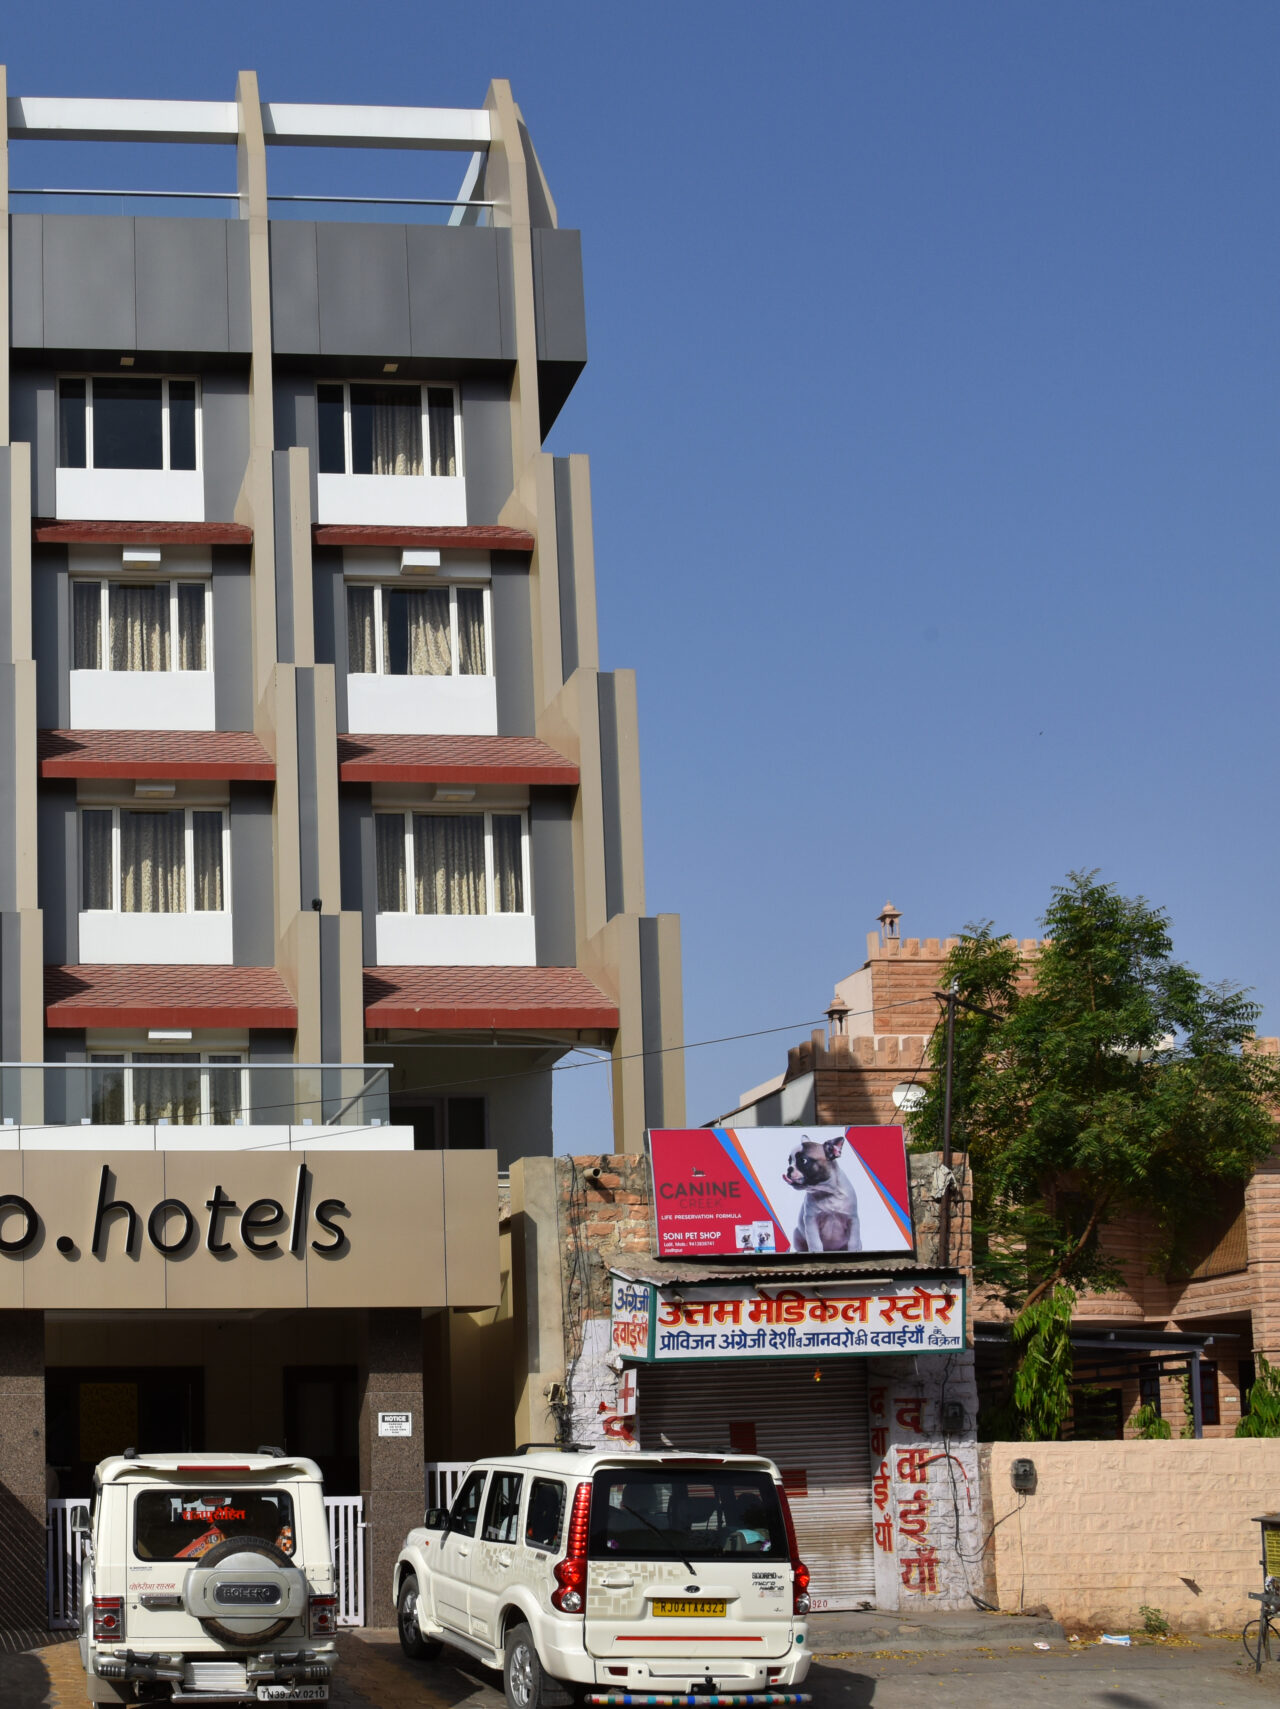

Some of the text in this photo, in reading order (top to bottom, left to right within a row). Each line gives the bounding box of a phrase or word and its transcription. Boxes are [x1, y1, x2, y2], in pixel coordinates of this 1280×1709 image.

[660, 1181, 741, 1199] CANINE
[679, 1199, 723, 1209] CREEK
[663, 1231, 722, 1240] SONI PET SHOP
[658, 1285, 958, 1327] उत्तम मेडिकल स्टोर
[660, 1330, 716, 1350] प्रोविजन
[718, 1328, 767, 1350] अंग्रेजी
[769, 1327, 797, 1350] देशी
[223, 1588, 270, 1600] BOLERO
[661, 1602, 725, 1613] RJ04TA4323
